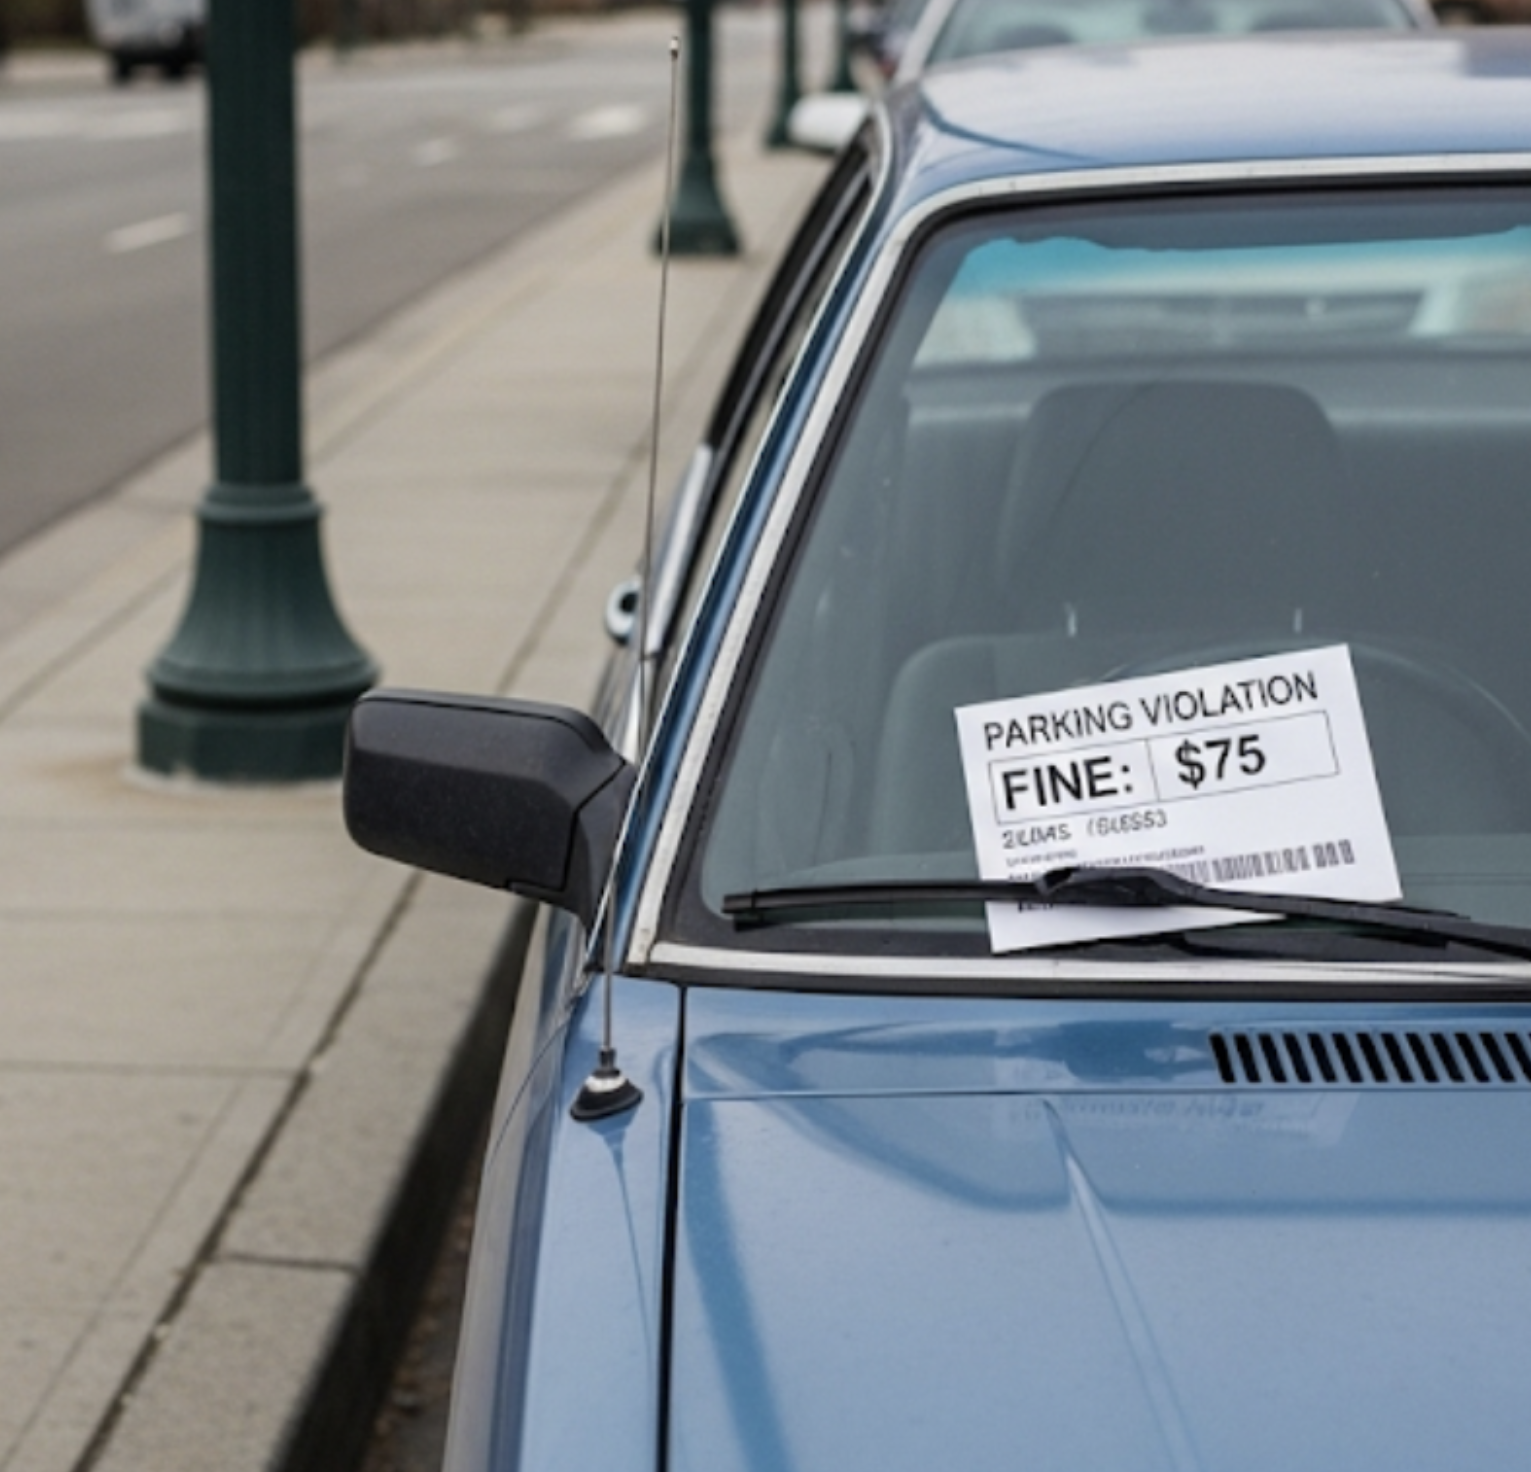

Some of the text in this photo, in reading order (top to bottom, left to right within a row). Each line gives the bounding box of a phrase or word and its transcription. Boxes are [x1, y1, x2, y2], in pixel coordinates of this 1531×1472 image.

[984, 671, 1319, 751] PARKING VIOLATION
[1002, 734, 1267, 809] FINE: $75
